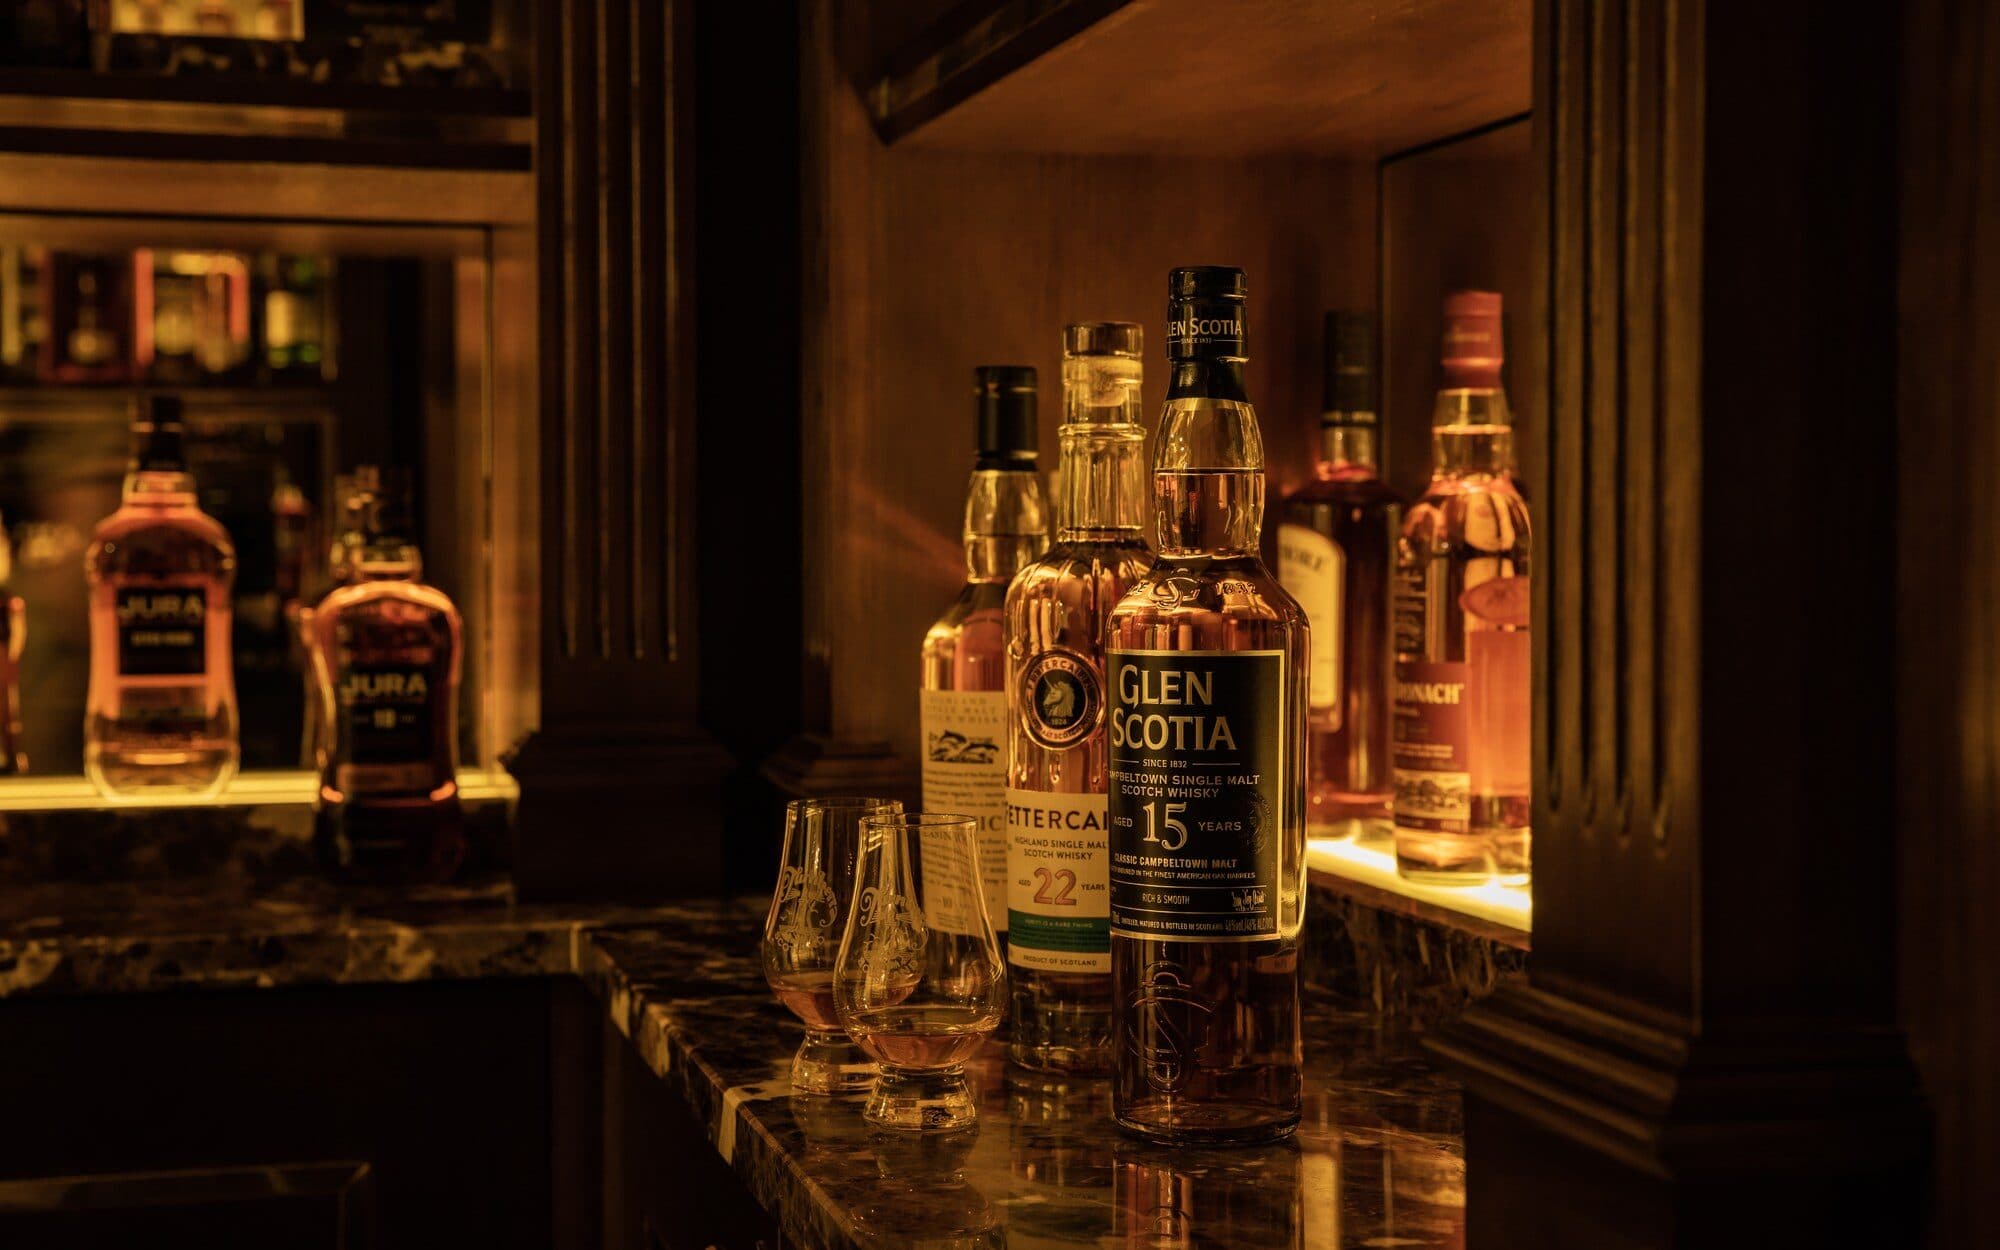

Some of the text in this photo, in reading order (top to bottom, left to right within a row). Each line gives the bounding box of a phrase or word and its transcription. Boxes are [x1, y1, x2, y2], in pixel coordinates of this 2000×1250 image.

[1167, 317, 1243, 337] LEN SCOTIA
[118, 595, 204, 622] JURA
[341, 673, 427, 706] JURA
[1119, 664, 1213, 709] GLEN
[1113, 707, 1238, 751] SCOTIA
[1142, 759, 1188, 768] SINCE 1832
[1172, 775, 1223, 786] SINGLE
[1227, 775, 1260, 785] MALT
[1121, 784, 1220, 799] SCOTCH WHISKY
[1009, 804, 1108, 831] ETTERCAI
[1113, 801, 1242, 851] AGED 15 YEARS
[1051, 840, 1085, 849] SINGLE
[1087, 841, 1107, 849] MAL
[1024, 848, 1093, 860] SCOTCH WHISKY
[1114, 852, 1238, 869] CLASSIC CAMPBELTOWN MALT
[1154, 871, 1175, 879] FINEST
[1033, 867, 1077, 906] 22
[1080, 883, 1106, 891] YEARS
[1142, 892, 1156, 904] RICH
[1163, 894, 1190, 905] SMOOTH
[1165, 921, 1188, 930] BOTTLED
